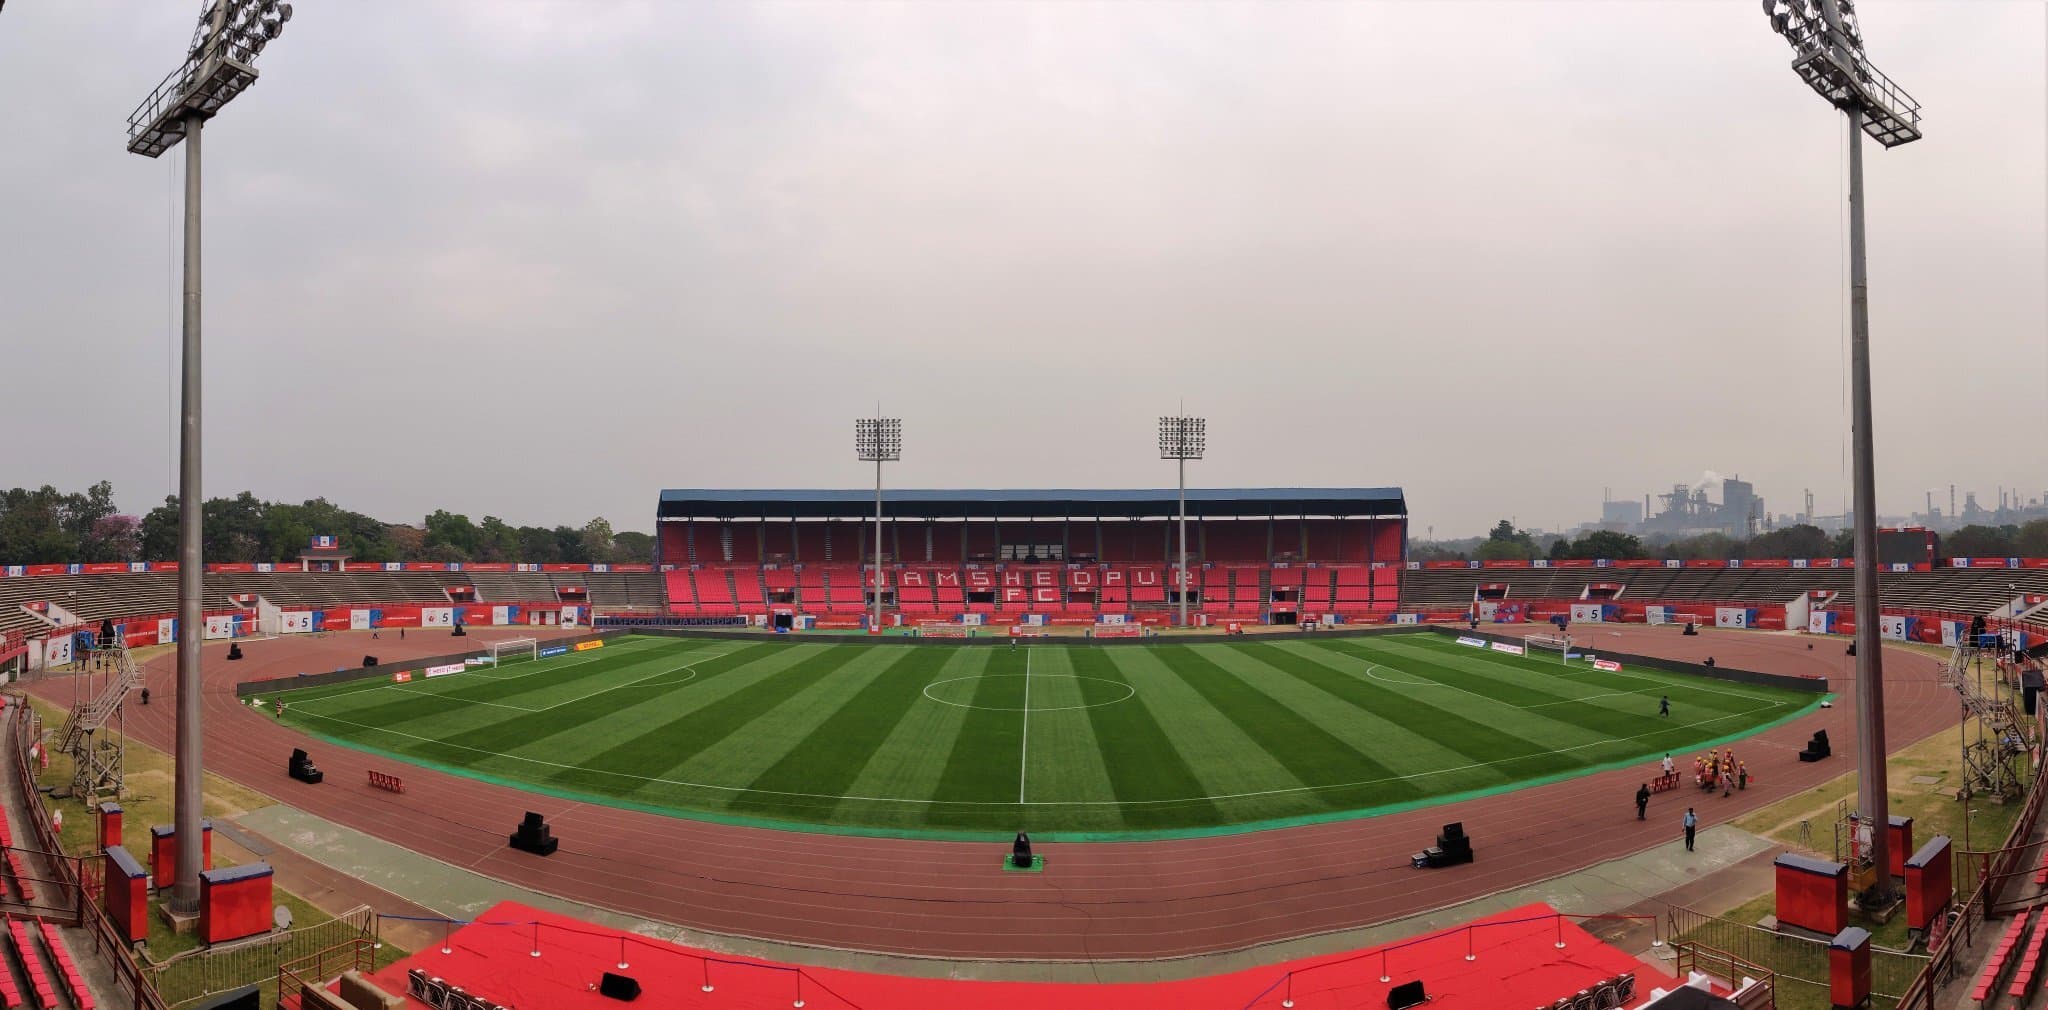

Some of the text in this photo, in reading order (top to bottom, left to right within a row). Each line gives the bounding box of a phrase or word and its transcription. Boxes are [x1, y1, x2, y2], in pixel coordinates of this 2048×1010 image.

[871, 571, 1193, 585] JAMSHEDPUR
[1007, 588, 1053, 601] FC
[442, 613, 449, 622] 5
[1591, 609, 1598, 619] 5
[1736, 614, 1743, 624] 5
[301, 617, 309, 628] 5
[1895, 622, 1902, 635] 5
[62, 643, 69, 657] 5
